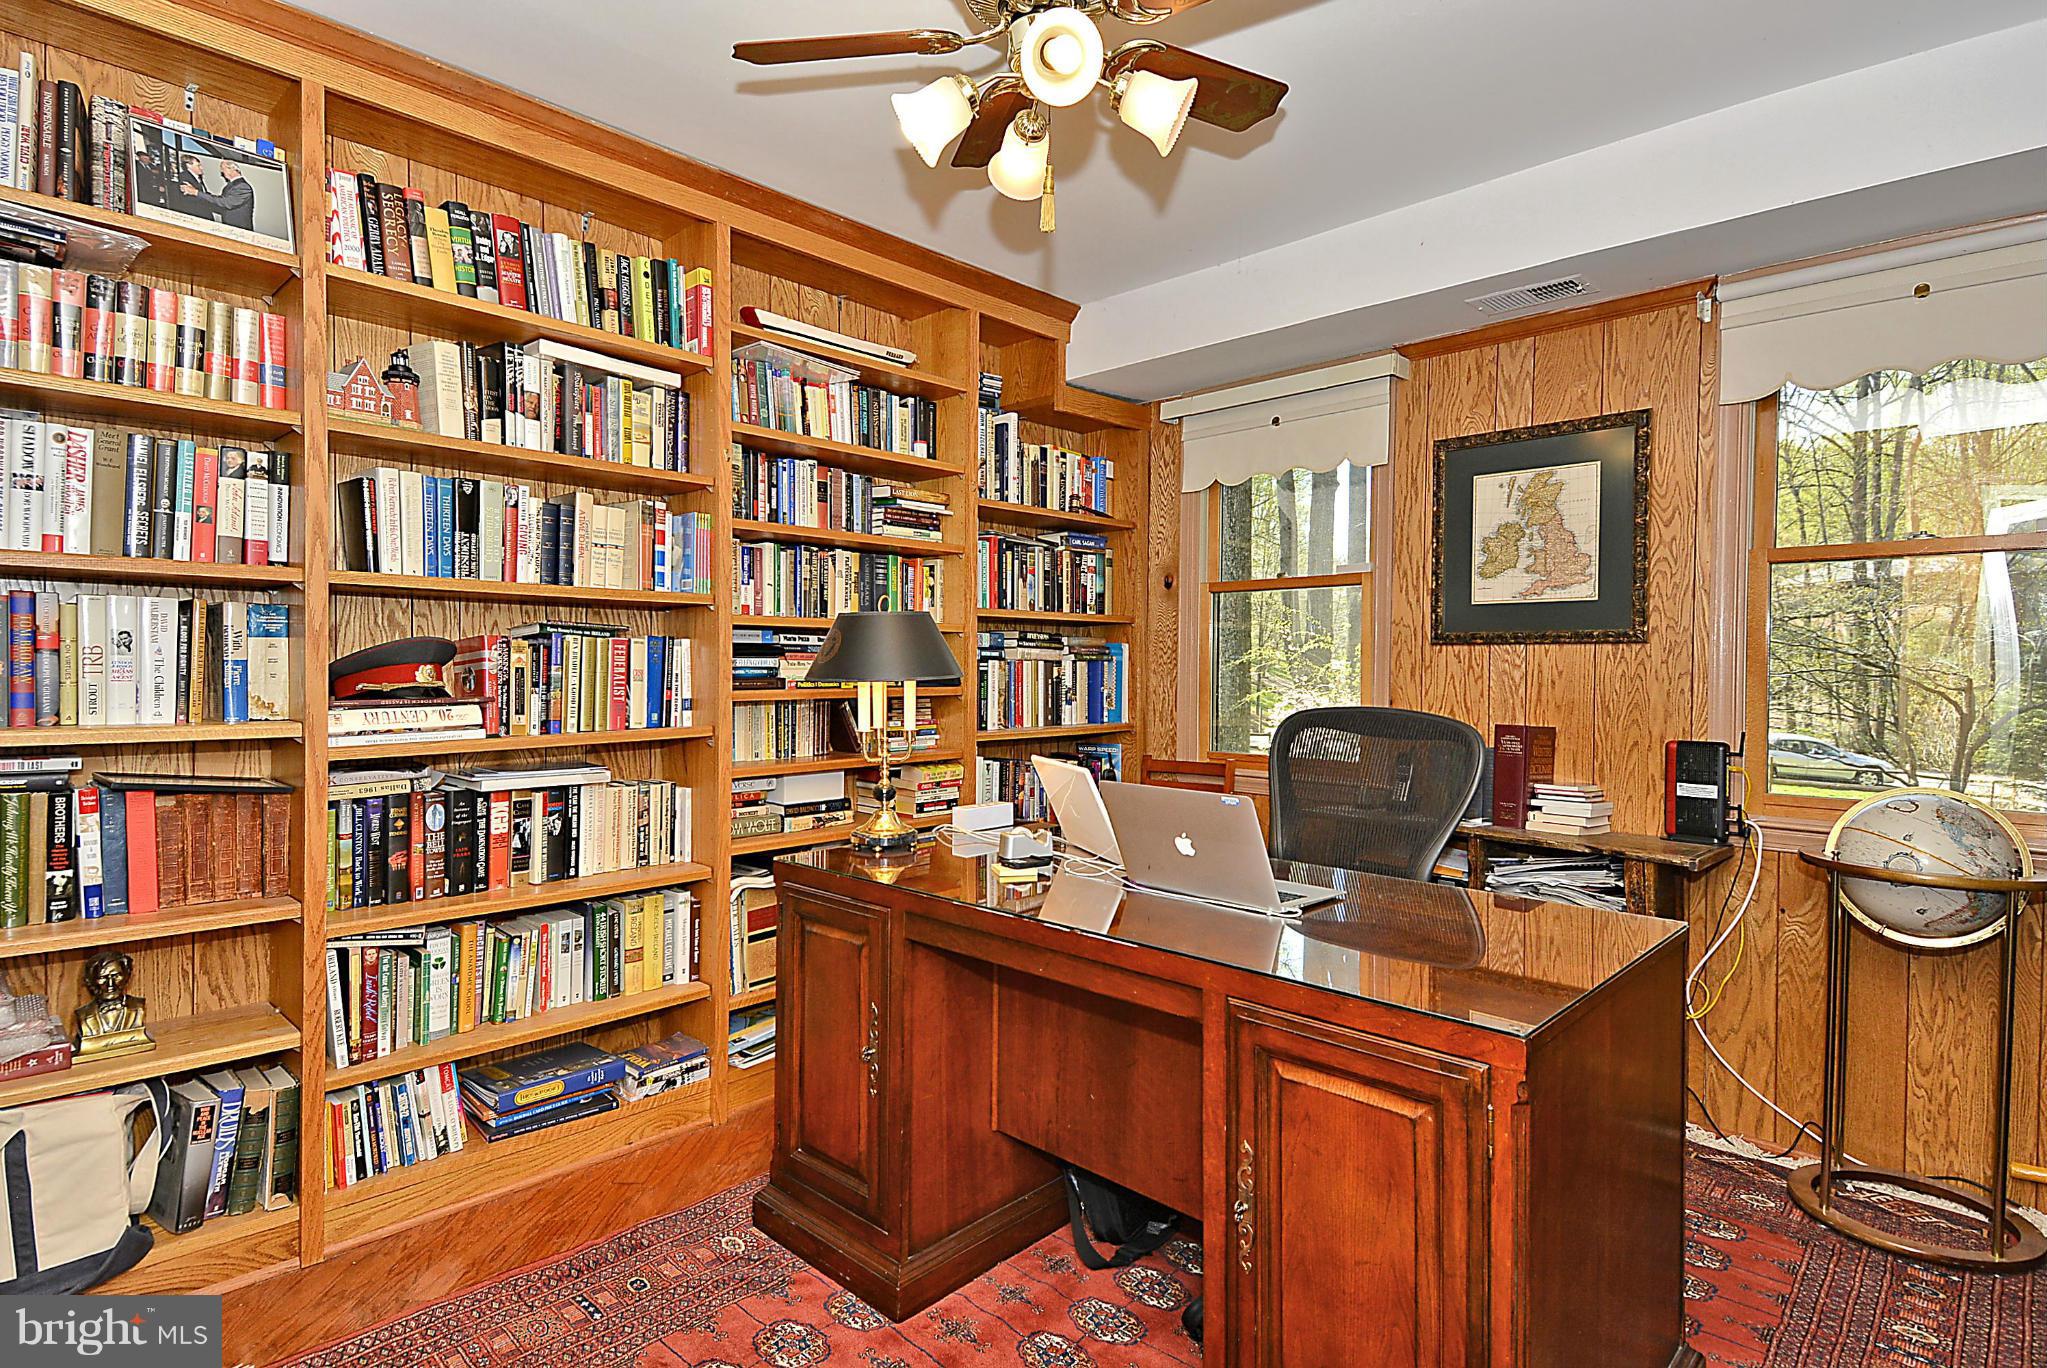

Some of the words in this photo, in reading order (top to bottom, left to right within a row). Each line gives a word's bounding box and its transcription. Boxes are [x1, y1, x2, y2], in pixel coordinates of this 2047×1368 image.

[43, 91, 53, 148] INDISPENSABLE
[368, 217, 381, 248] GERRY
[382, 192, 398, 256] SECRECY
[393, 193, 407, 243] LEGACY
[620, 257, 630, 275] JACK
[621, 275, 630, 306] HIGGINS
[22, 424, 36, 473] SHADOW
[67, 431, 87, 482] DASHER
[136, 511, 148, 545] SECRETS
[519, 524, 528, 555] GIVING
[443, 537, 451, 556] DAYS
[160, 613, 168, 632] DAVID
[65, 644, 72, 654] ON
[82, 645, 103, 678] TRB
[154, 658, 164, 673] The
[612, 645, 626, 701] FEDERALIST
[88, 683, 97, 715] STROUT
[153, 675, 164, 709] Children
[362, 711, 428, 726] CENTURY
[381, 783, 407, 792] Dallas
[54, 796, 66, 844] BROTHERS
[355, 808, 363, 822] BILL
[490, 801, 509, 835] KGB
[425, 832, 445, 840] THE
[426, 839, 445, 848] BELL
[355, 856, 363, 871] Back
[629, 916, 637, 947] IRELAND
[327, 954, 338, 985] IRELAND
[215, 1101, 242, 1150] DRUIDS
